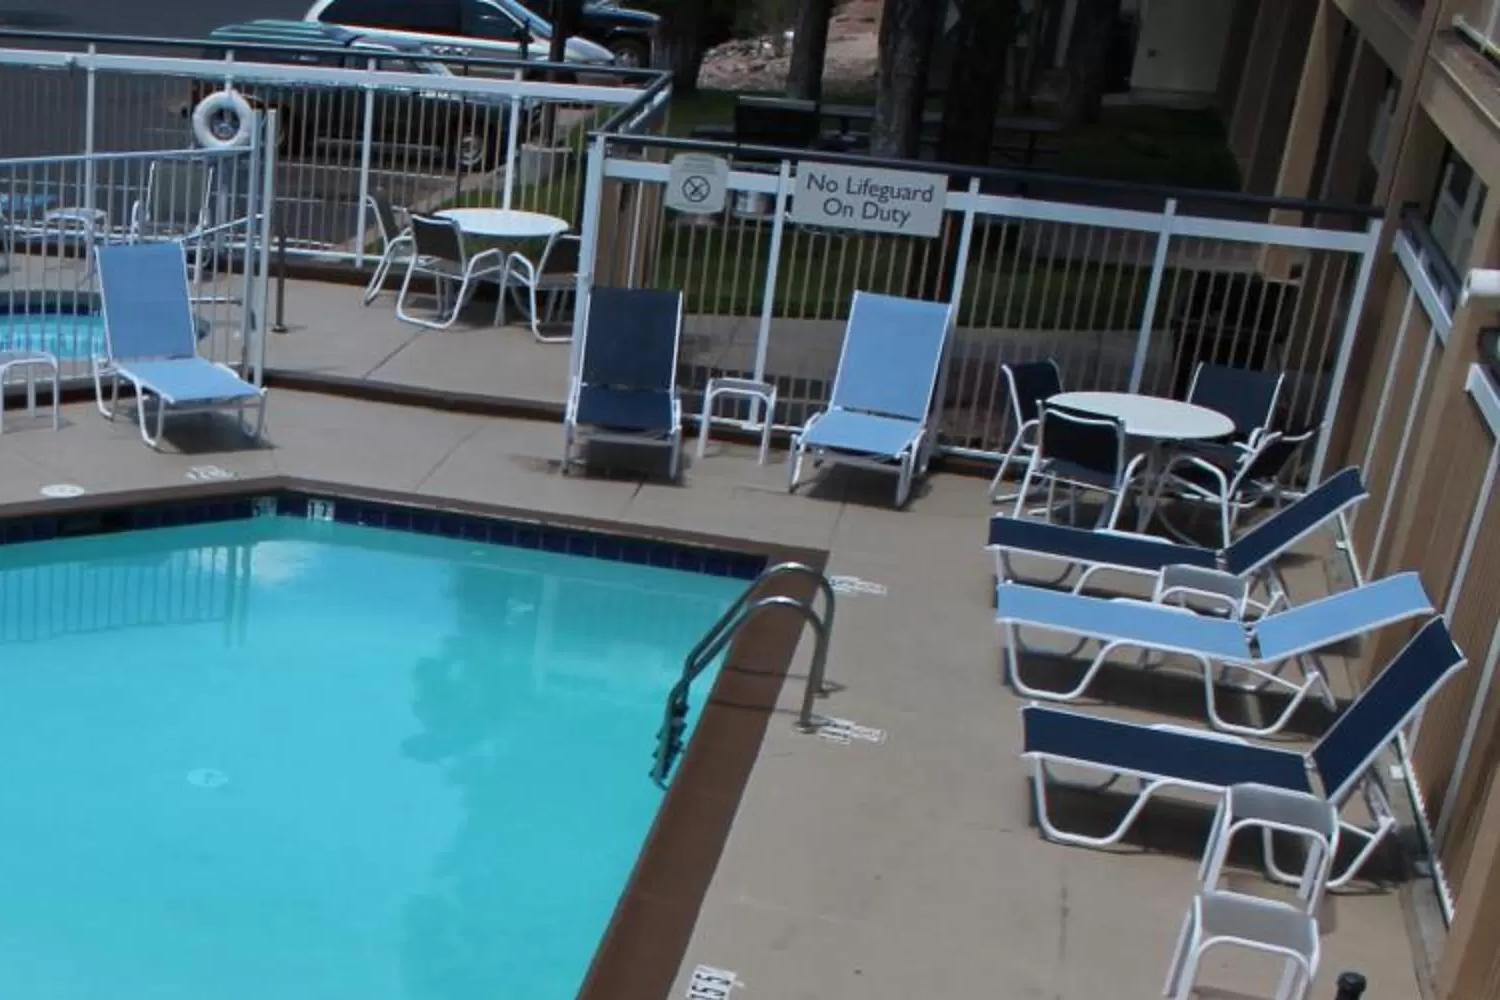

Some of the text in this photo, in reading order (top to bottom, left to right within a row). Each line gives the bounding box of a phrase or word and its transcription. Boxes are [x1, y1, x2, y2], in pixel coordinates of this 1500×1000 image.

[806, 172, 935, 205] No Lifeguard
[823, 196, 911, 227] On Duty
